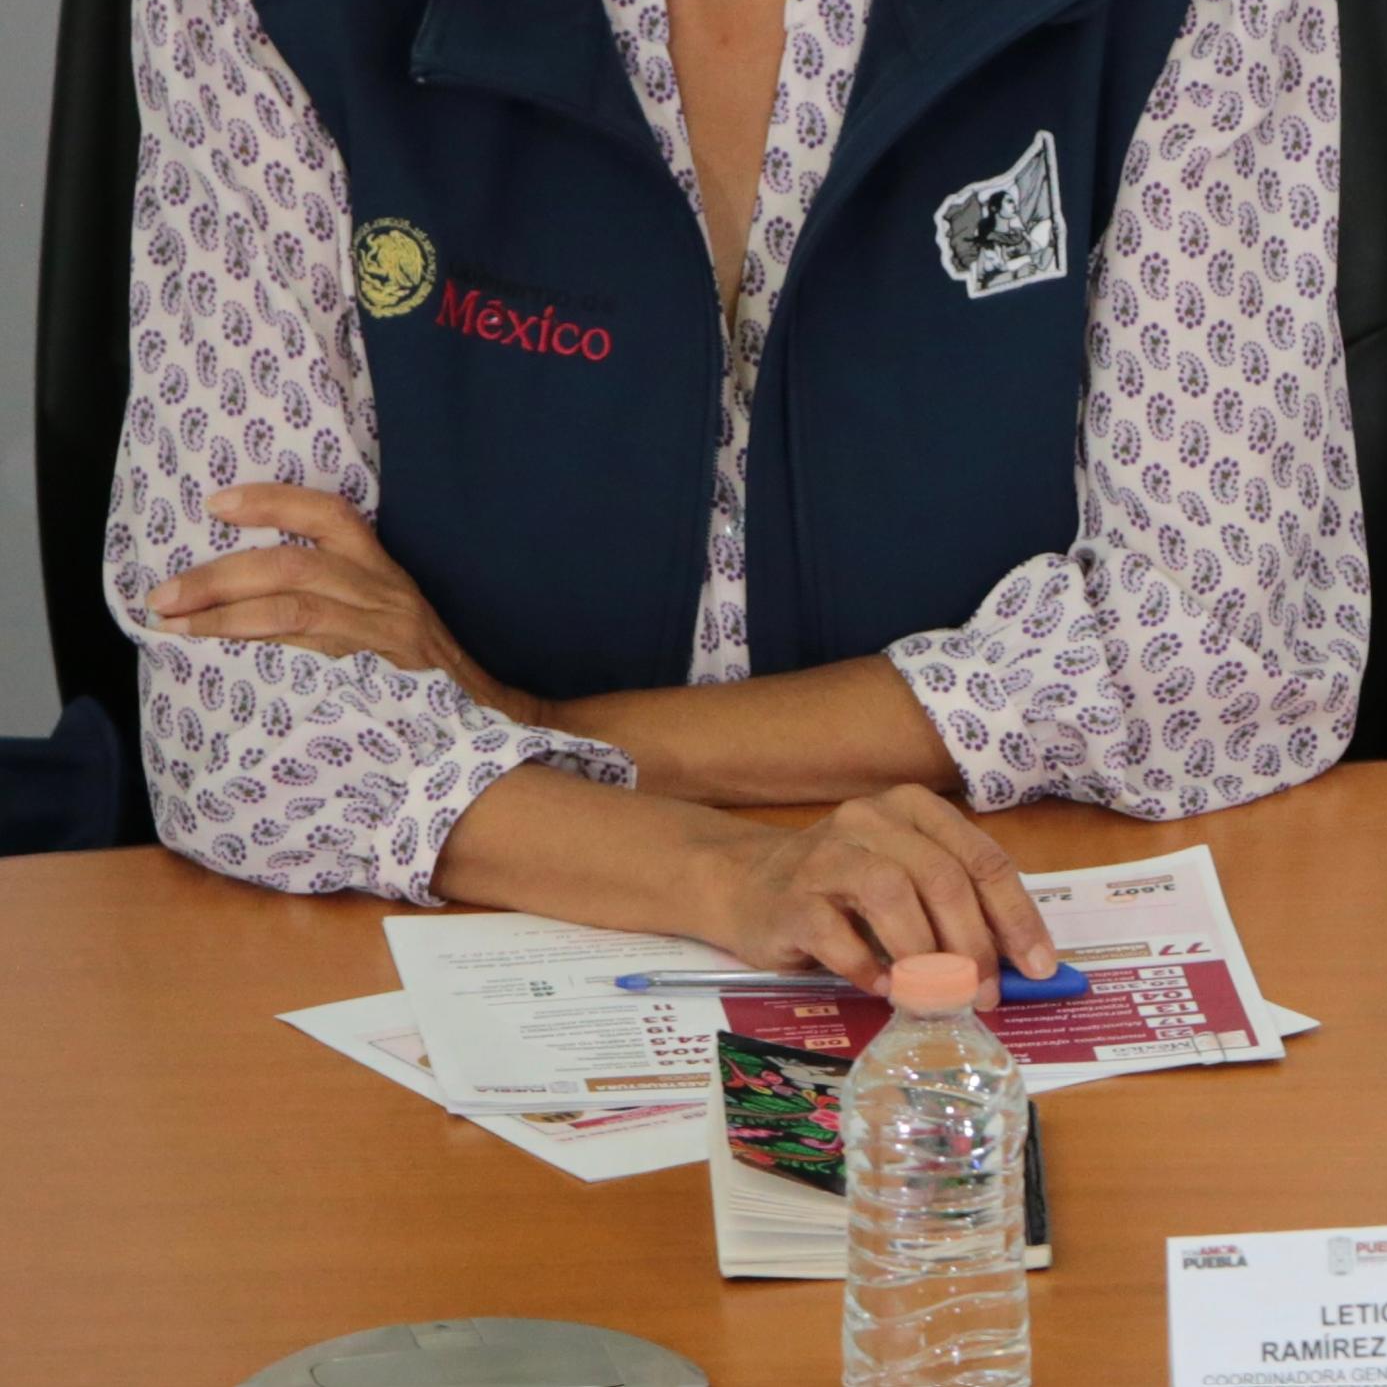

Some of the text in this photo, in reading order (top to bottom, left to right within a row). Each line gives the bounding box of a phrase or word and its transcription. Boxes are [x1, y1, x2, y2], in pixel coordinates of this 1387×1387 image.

[434, 278, 611, 362] México
[1158, 942, 1211, 956] 77
[1182, 1253, 1248, 1270] PUEBLA
[1261, 1332, 1387, 1364] RAMÍREZ
[1203, 1367, 1350, 1386] COORDINADORA
